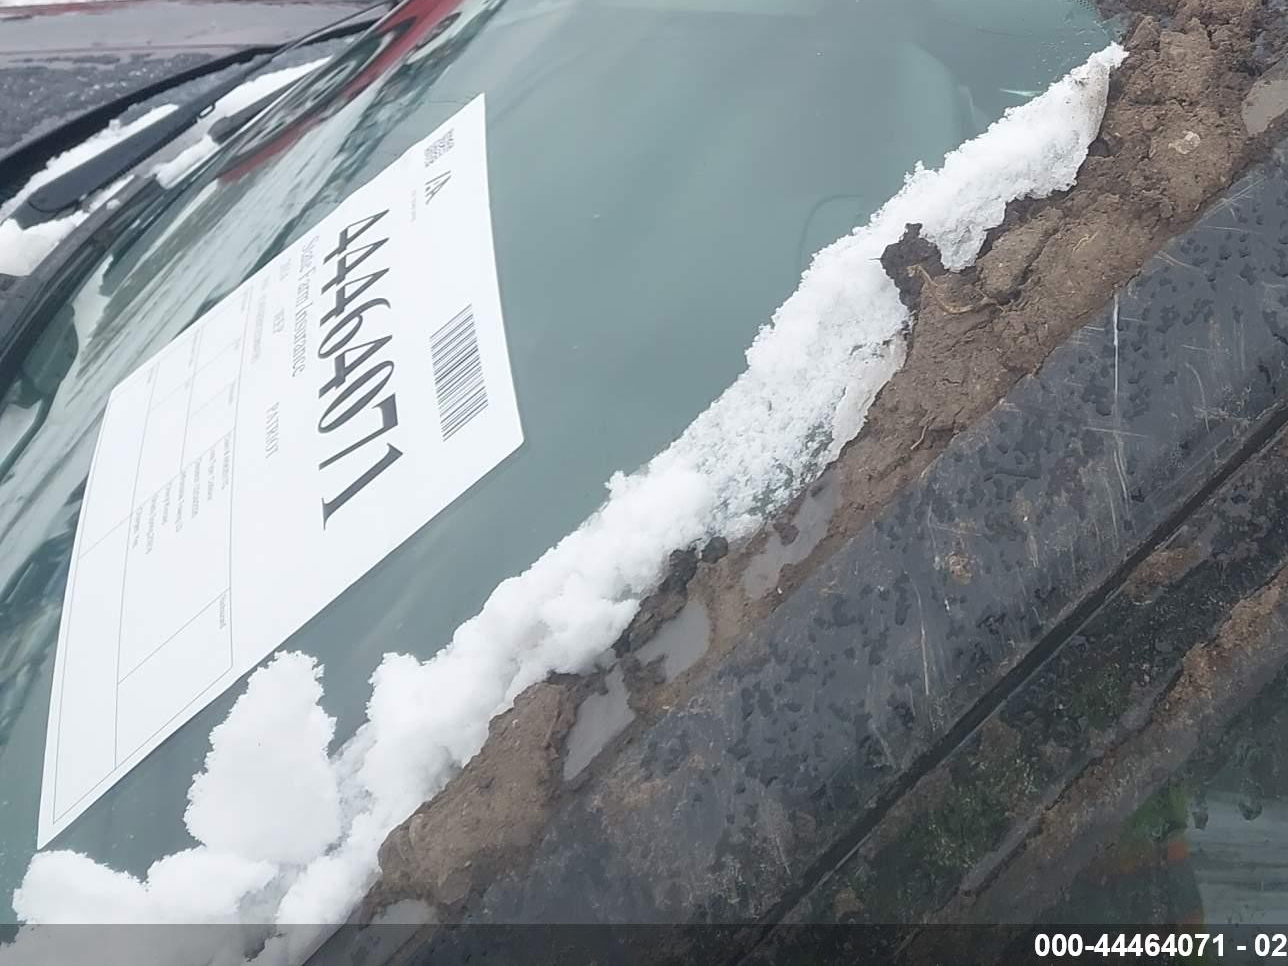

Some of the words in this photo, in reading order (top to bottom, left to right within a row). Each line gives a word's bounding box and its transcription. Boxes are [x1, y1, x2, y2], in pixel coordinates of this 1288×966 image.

[299, 235, 319, 273] State
[295, 265, 316, 308] Farm
[291, 302, 313, 378] Insurance
[318, 209, 404, 531] 44464071
[264, 400, 280, 459] PATRIOT
